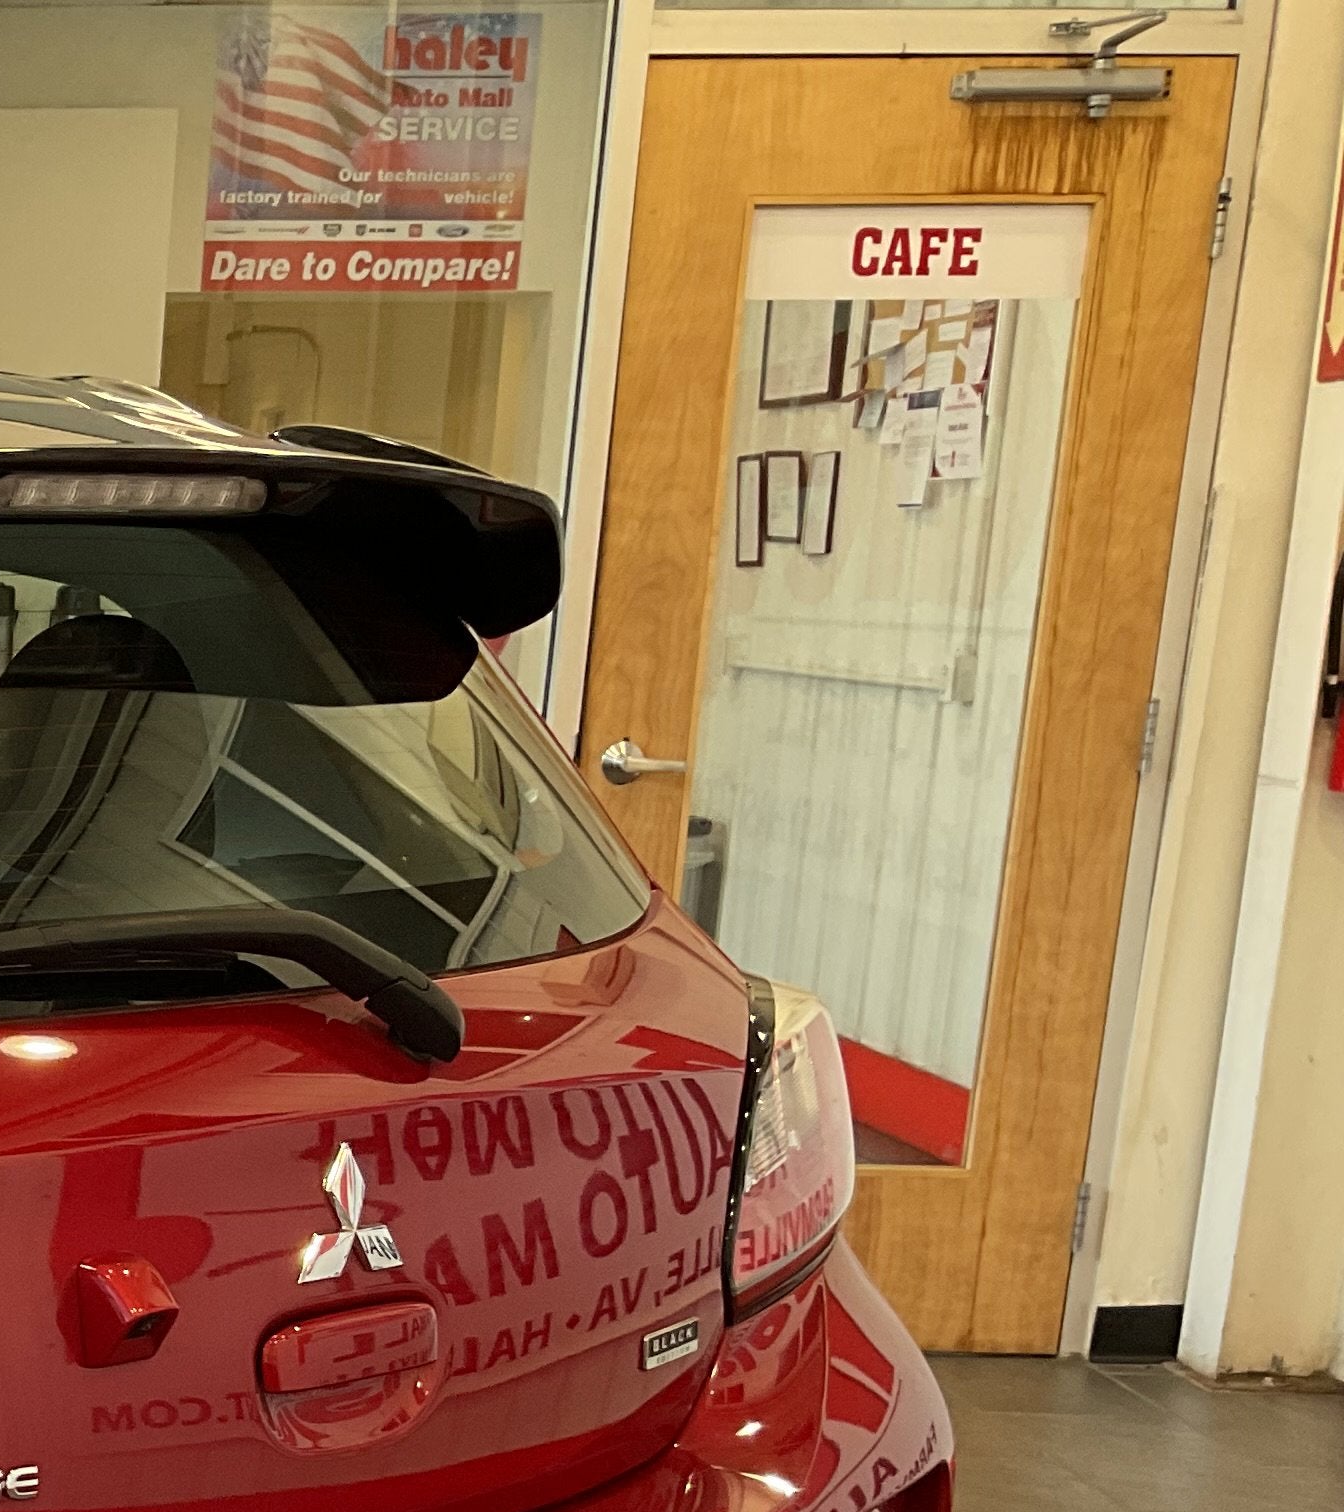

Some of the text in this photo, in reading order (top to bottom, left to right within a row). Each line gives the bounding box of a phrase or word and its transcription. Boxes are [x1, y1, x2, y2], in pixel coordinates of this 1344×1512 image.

[383, 23, 529, 82] haley
[392, 87, 514, 108] Auto Mall
[377, 117, 520, 141] SERVICE
[338, 167, 516, 182] Our technicians are
[219, 189, 282, 208] factory
[287, 189, 351, 204] trained
[355, 189, 383, 208] for
[444, 189, 515, 204] vehicle!
[851, 226, 984, 277] CAFE
[211, 250, 516, 288] Dare to Compare!
[652, 1326, 693, 1353] BLACK
